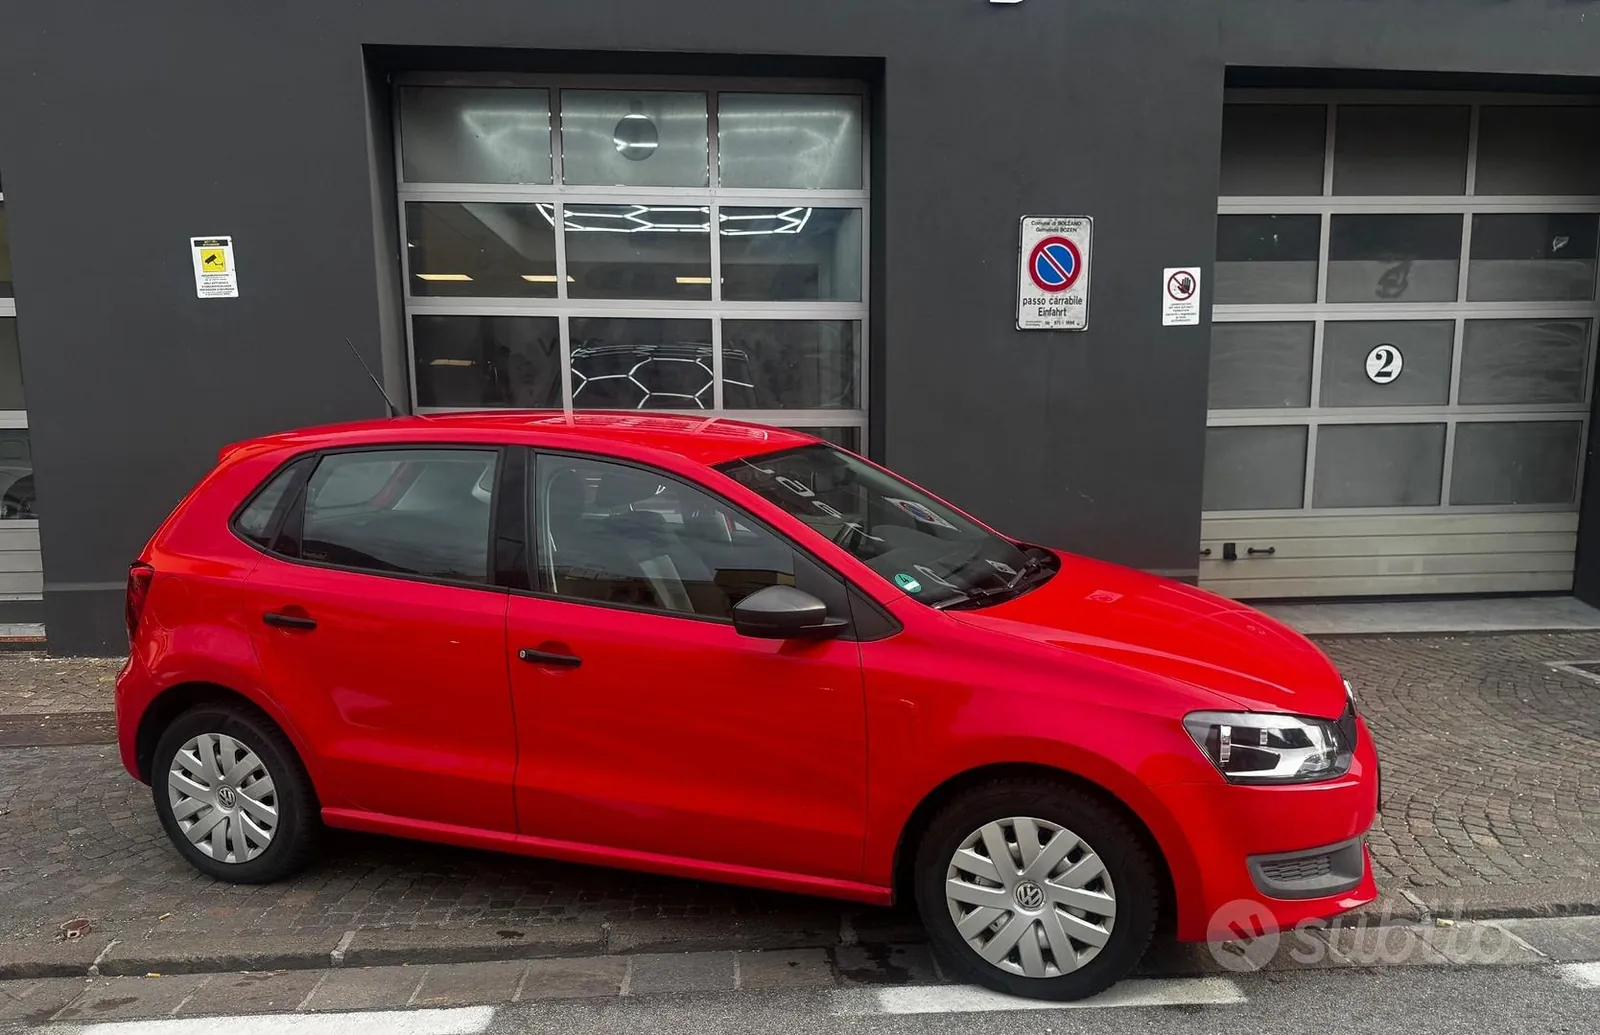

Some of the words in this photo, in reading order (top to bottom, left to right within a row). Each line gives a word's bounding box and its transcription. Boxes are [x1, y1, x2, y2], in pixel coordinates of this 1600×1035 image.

[1022, 297, 1046, 306] passo
[1049, 296, 1082, 305] carrabile
[1038, 307, 1066, 316] Einfahrt
[1374, 349, 1394, 377] 2
